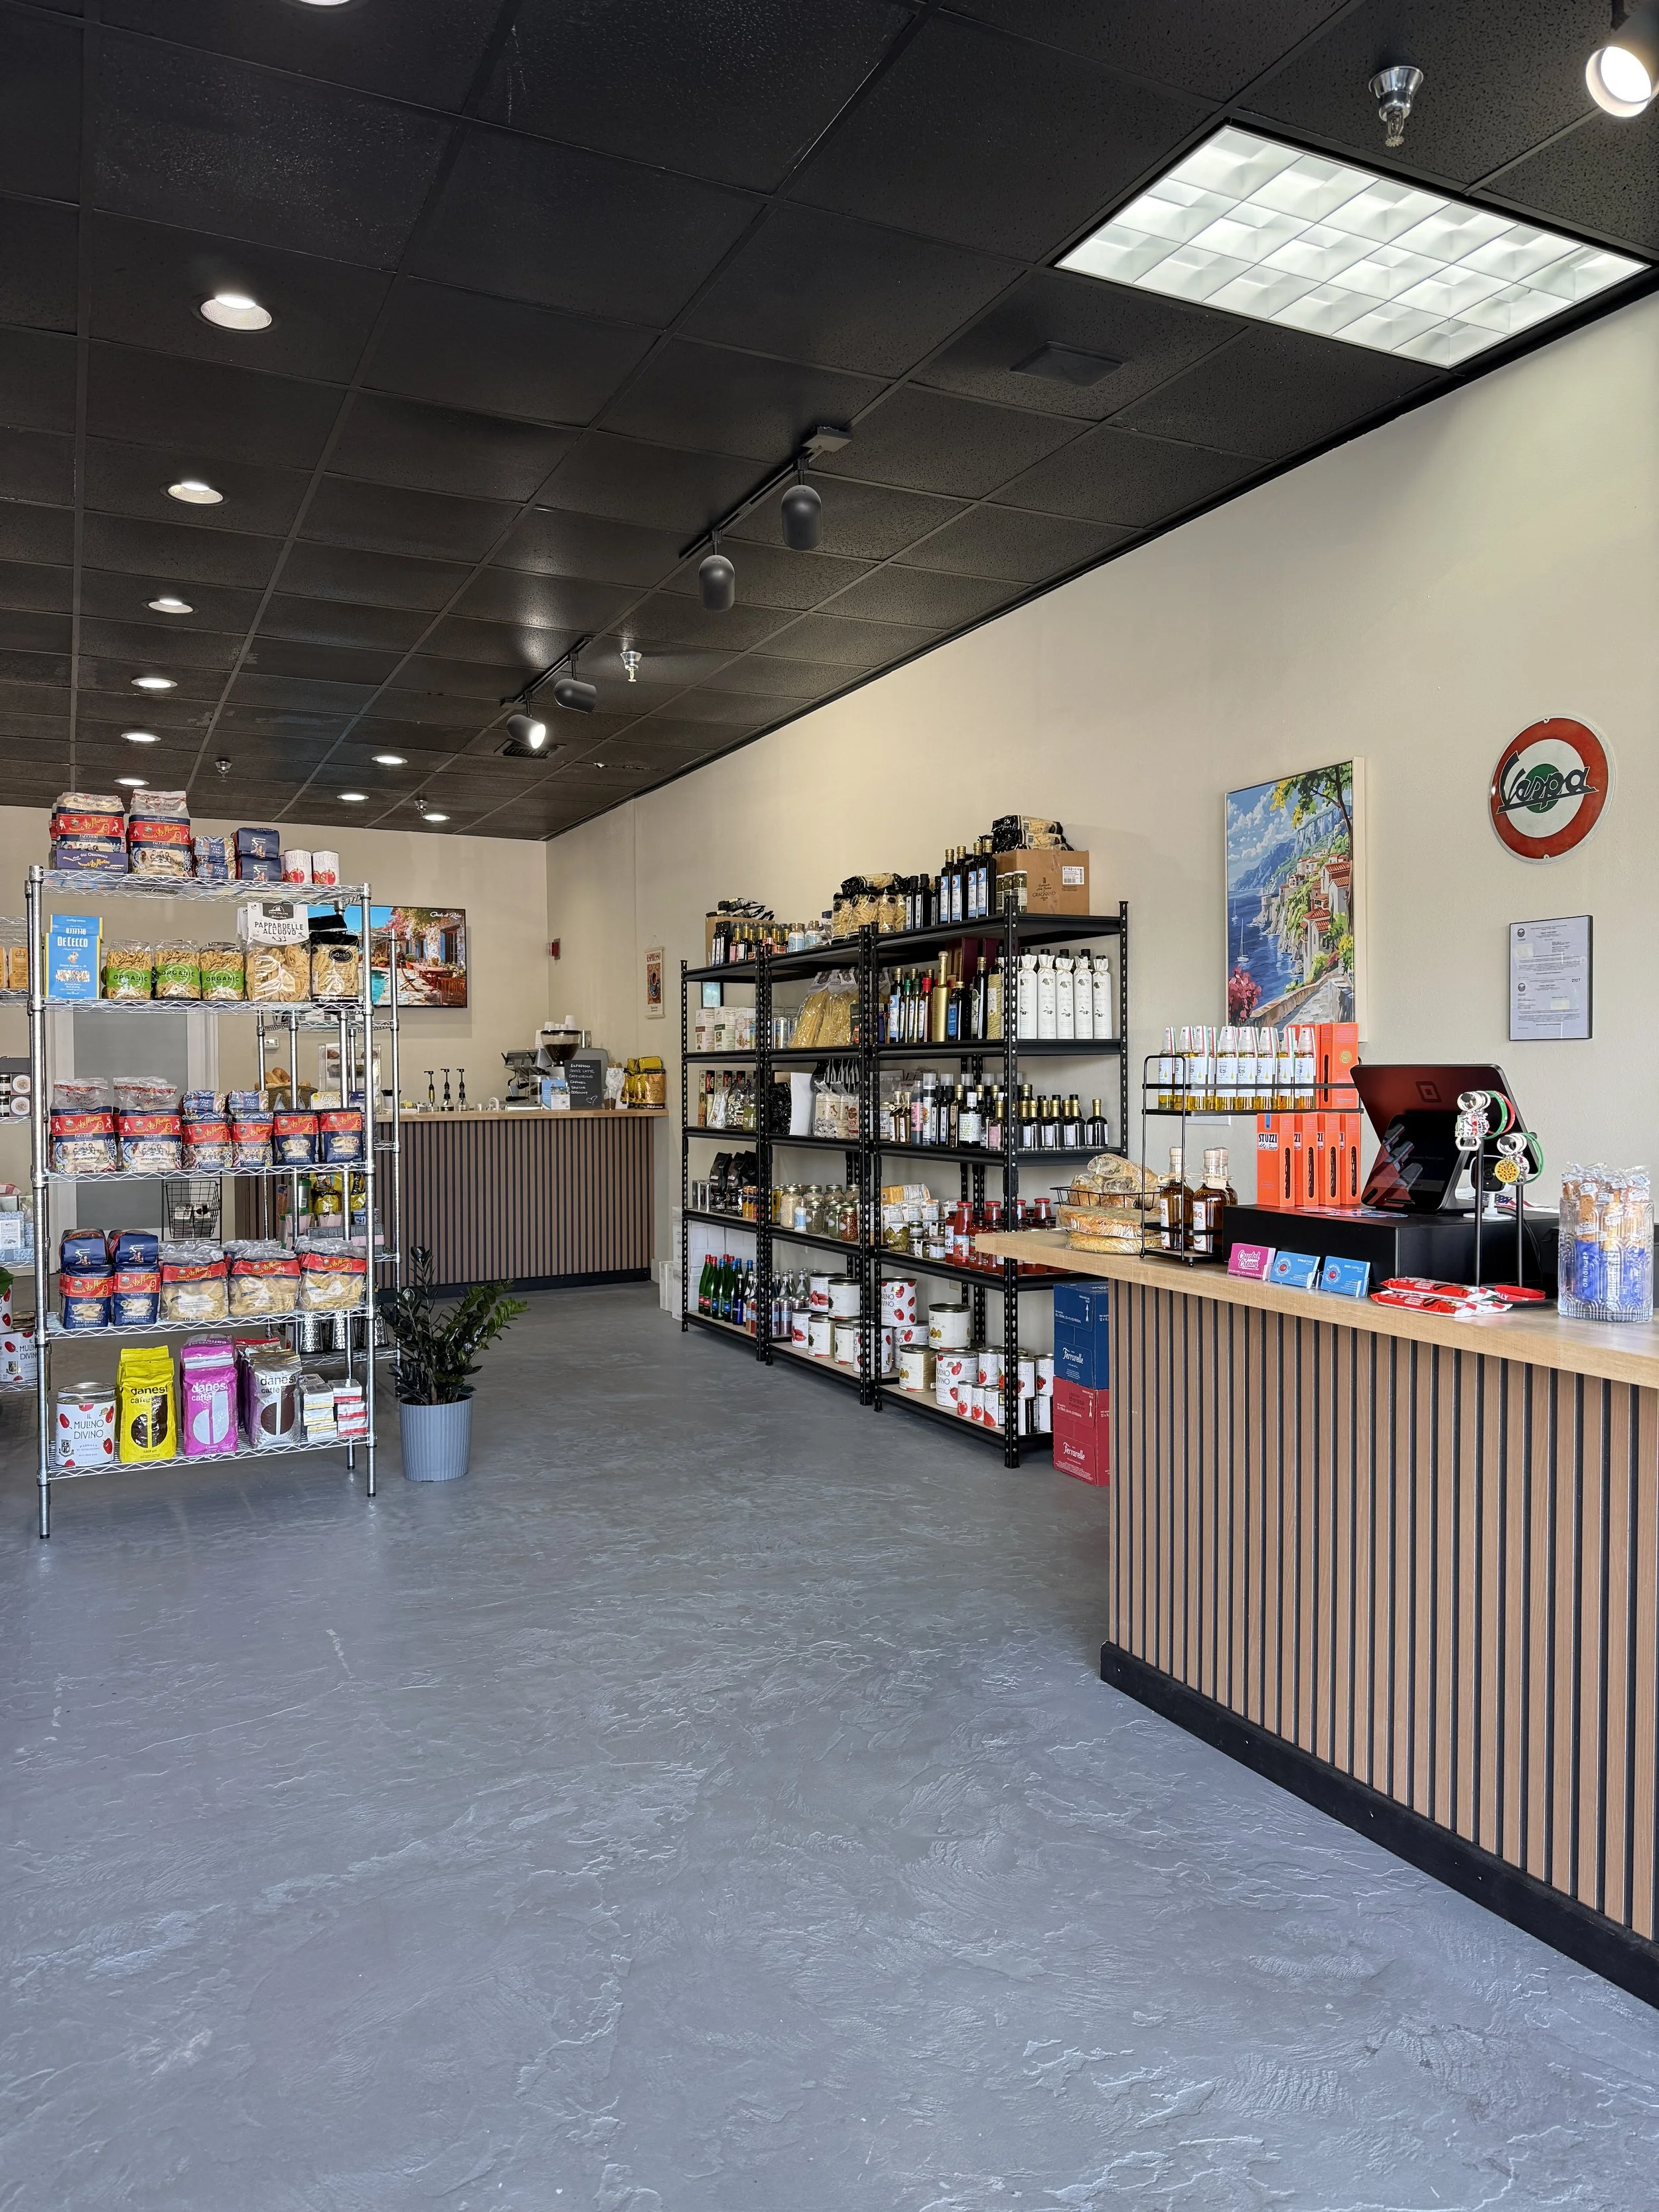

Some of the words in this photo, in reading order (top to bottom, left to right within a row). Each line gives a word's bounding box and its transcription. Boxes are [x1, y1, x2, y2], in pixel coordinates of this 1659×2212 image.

[1496, 751, 1599, 814] Vespa
[254, 922, 303, 930] PAPPARDELLE
[113, 974, 148, 982] ORGANIC
[161, 970, 195, 979] ORGANIC
[321, 1094, 337, 1103] Lago
[1258, 1134, 1277, 1143] STUZZI
[1238, 1249, 1261, 1262] Crystal
[1239, 1259, 1259, 1268] Cream
[1062, 1347, 1084, 1364] Ferrarelle
[261, 1376, 296, 1386] danesi
[131, 1386, 168, 1395] danesi
[192, 1382, 228, 1393] danesi
[74, 1420, 104, 1430] MULINO
[74, 1430, 104, 1439] DIVINO
[1063, 1441, 1085, 1461] Ferrarelle
